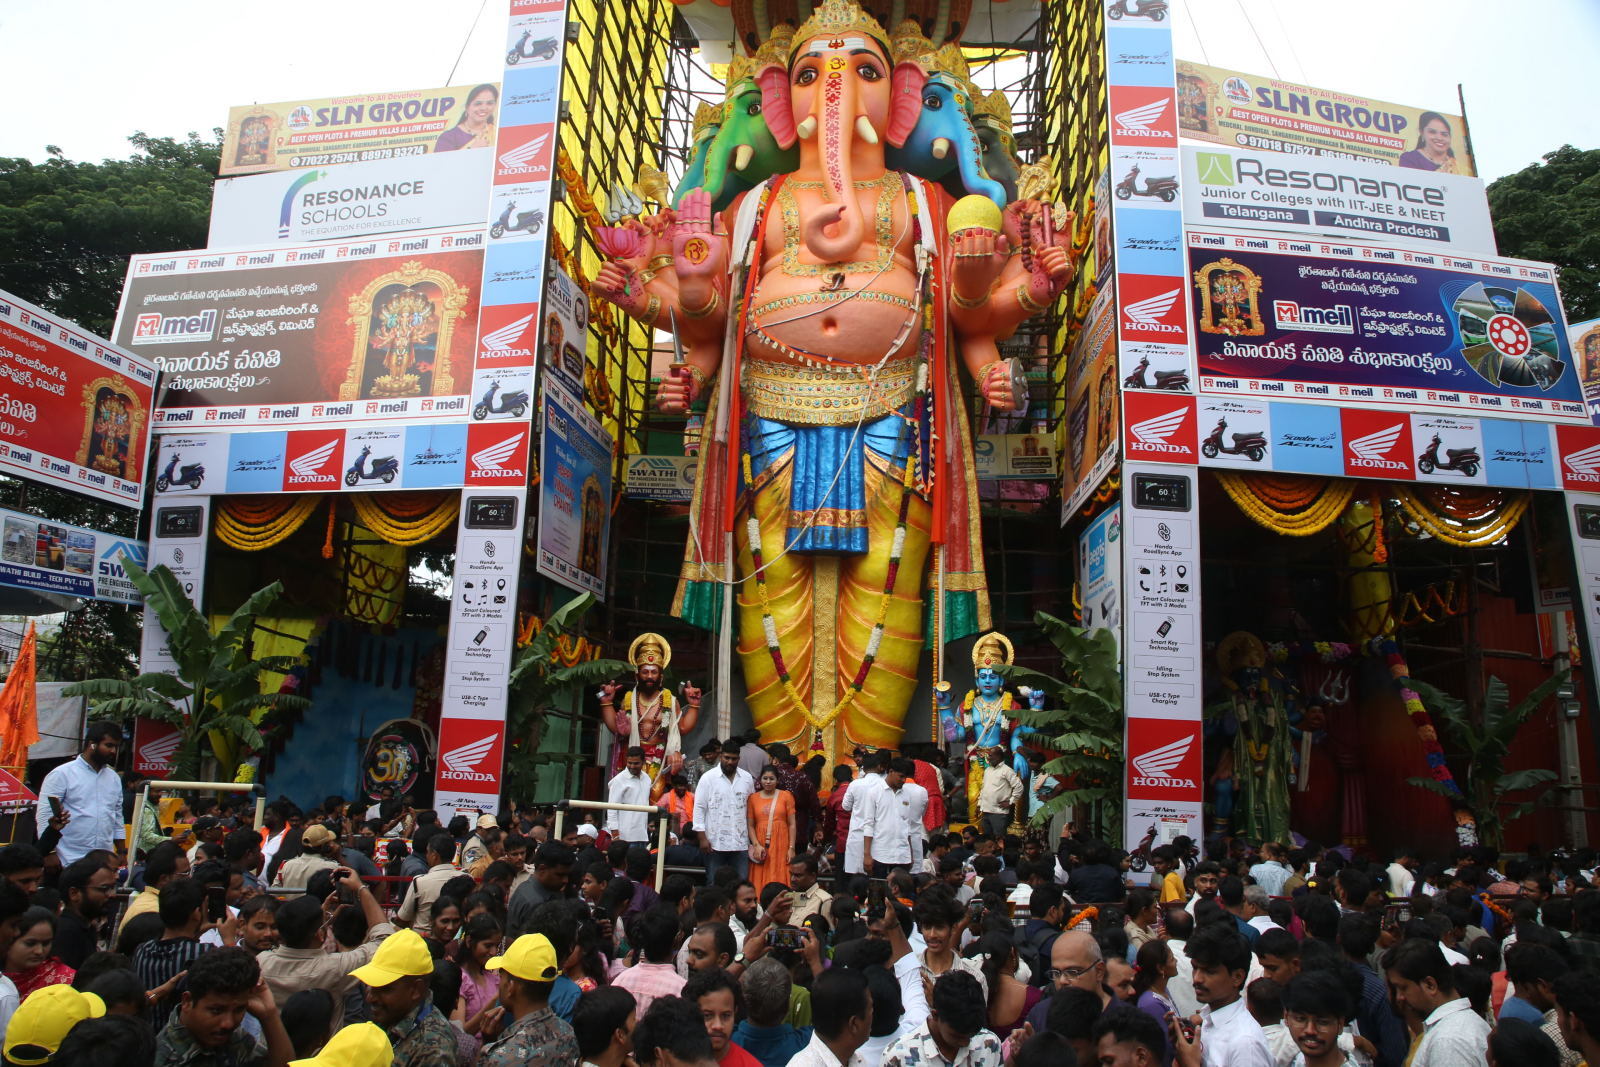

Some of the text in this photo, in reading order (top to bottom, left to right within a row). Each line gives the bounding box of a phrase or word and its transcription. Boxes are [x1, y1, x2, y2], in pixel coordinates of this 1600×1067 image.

[1270, 80, 1369, 106] Welcome To All Devotees
[316, 97, 455, 127] SLN GROUP
[1255, 86, 1408, 134] SLN GROUP
[308, 134, 323, 142] OPEN
[325, 132, 342, 140] PLOTS
[350, 129, 377, 138] PREMIUM
[380, 127, 399, 135] VILLAS
[408, 124, 421, 132] LOW
[1116, 129, 1174, 138] HONDA
[1232, 110, 1250, 120] BEST
[1251, 113, 1270, 123] OPEN
[1271, 117, 1292, 128] PLOTS
[1300, 122, 1331, 135] PREMIUM
[1332, 128, 1355, 140] VILLAS
[1364, 135, 1379, 144] LOW
[1380, 137, 1403, 148] PRICES
[1248, 137, 1282, 152] 97018
[300, 155, 328, 165] 77022
[361, 149, 391, 160] 88979
[394, 146, 423, 156] 93274
[498, 164, 546, 175] HONDA
[1236, 158, 1445, 207] Resonance
[303, 181, 424, 207] RESONANCE
[1201, 187, 1446, 222] Junior Colleges with IIT-JEE & NEET
[301, 203, 387, 225] SCHOOLS
[1220, 205, 1294, 221] Telangana
[317, 224, 354, 234] EQUATION
[373, 217, 422, 228] EXCELLENCE
[1333, 214, 1439, 239] Andhra Pradesh
[152, 245, 376, 272] meil meil
[1290, 244, 1473, 270] meil meil
[548, 282, 572, 308] SWATHI
[310, 305, 319, 313] &
[1304, 307, 1351, 325] meil
[164, 312, 217, 334] meil
[1435, 315, 1444, 323] &
[1124, 322, 1184, 333] HONDA
[104, 352, 121, 366] meil
[235, 350, 281, 369] చవితి
[480, 348, 532, 359] HONDA
[1223, 340, 1452, 374] వినాయక చవితి శుభాకాంక్షలు
[60, 371, 68, 382] &
[169, 373, 255, 392] శుభాకాంక్షలు
[1216, 380, 1239, 389] meil
[1396, 390, 1417, 399] meil
[1563, 403, 1583, 412] meil
[167, 401, 408, 421] meil meil
[1277, 441, 1333, 449] ACTIVA
[1280, 433, 1318, 442] Scooter
[1130, 442, 1192, 454] HONDA
[1350, 458, 1409, 470] HONDA
[88, 472, 105, 485] meil
[288, 469, 523, 483] HONDA HONDA
[629, 469, 677, 477] SWATHI
[1158, 488, 1168, 496] 60
[24, 568, 41, 578] BUILD
[49, 574, 62, 583] TECH
[112, 589, 124, 598] MOVE
[1148, 644, 1179, 652] Technology
[1152, 698, 1178, 706] Charging
[138, 762, 177, 771] HON
[441, 771, 496, 782] HONDA
[1132, 776, 1197, 788] HONDA
